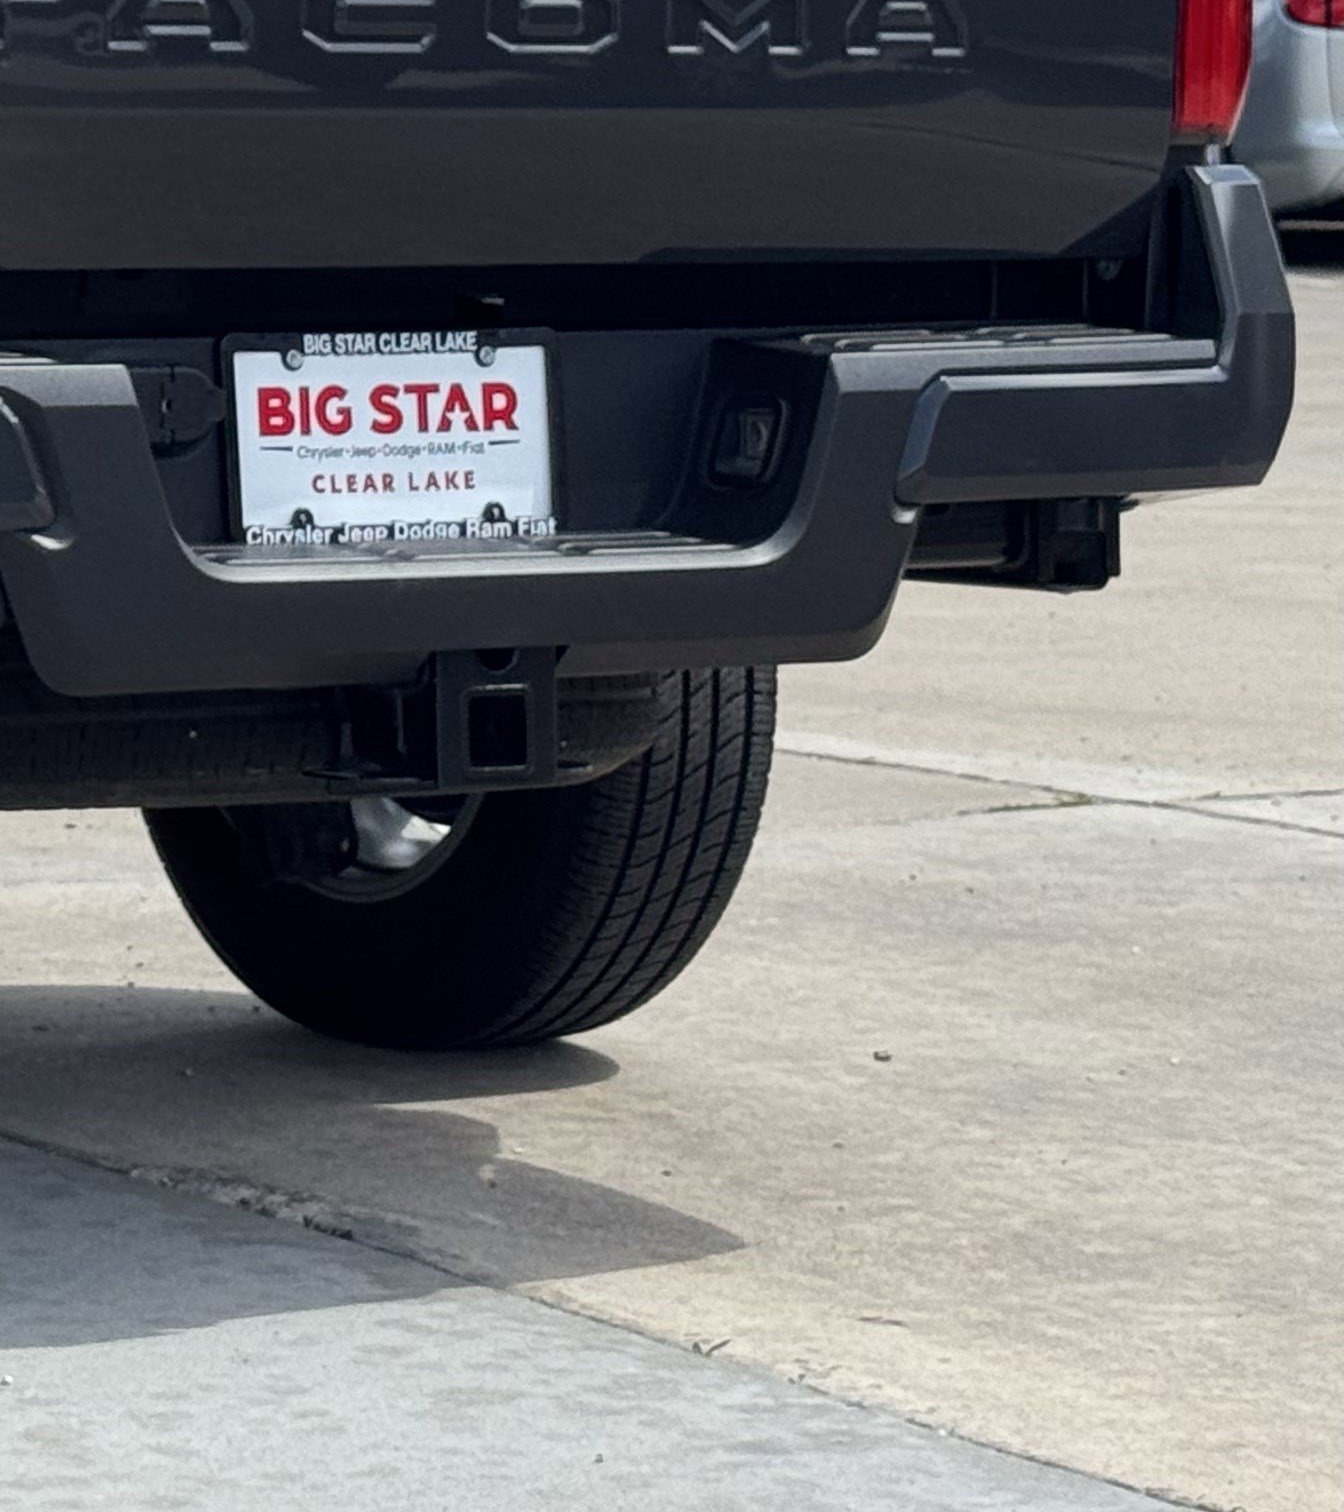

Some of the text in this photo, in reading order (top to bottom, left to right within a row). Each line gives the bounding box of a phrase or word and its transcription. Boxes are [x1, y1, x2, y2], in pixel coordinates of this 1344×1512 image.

[302, 329, 479, 355] BIG STAR CLEAR LAKE
[256, 381, 521, 437] BIG STAR
[311, 469, 477, 494] CLEAR LAKE
[245, 516, 559, 546] Chrysler Jeep Dodge Ram Fiat
